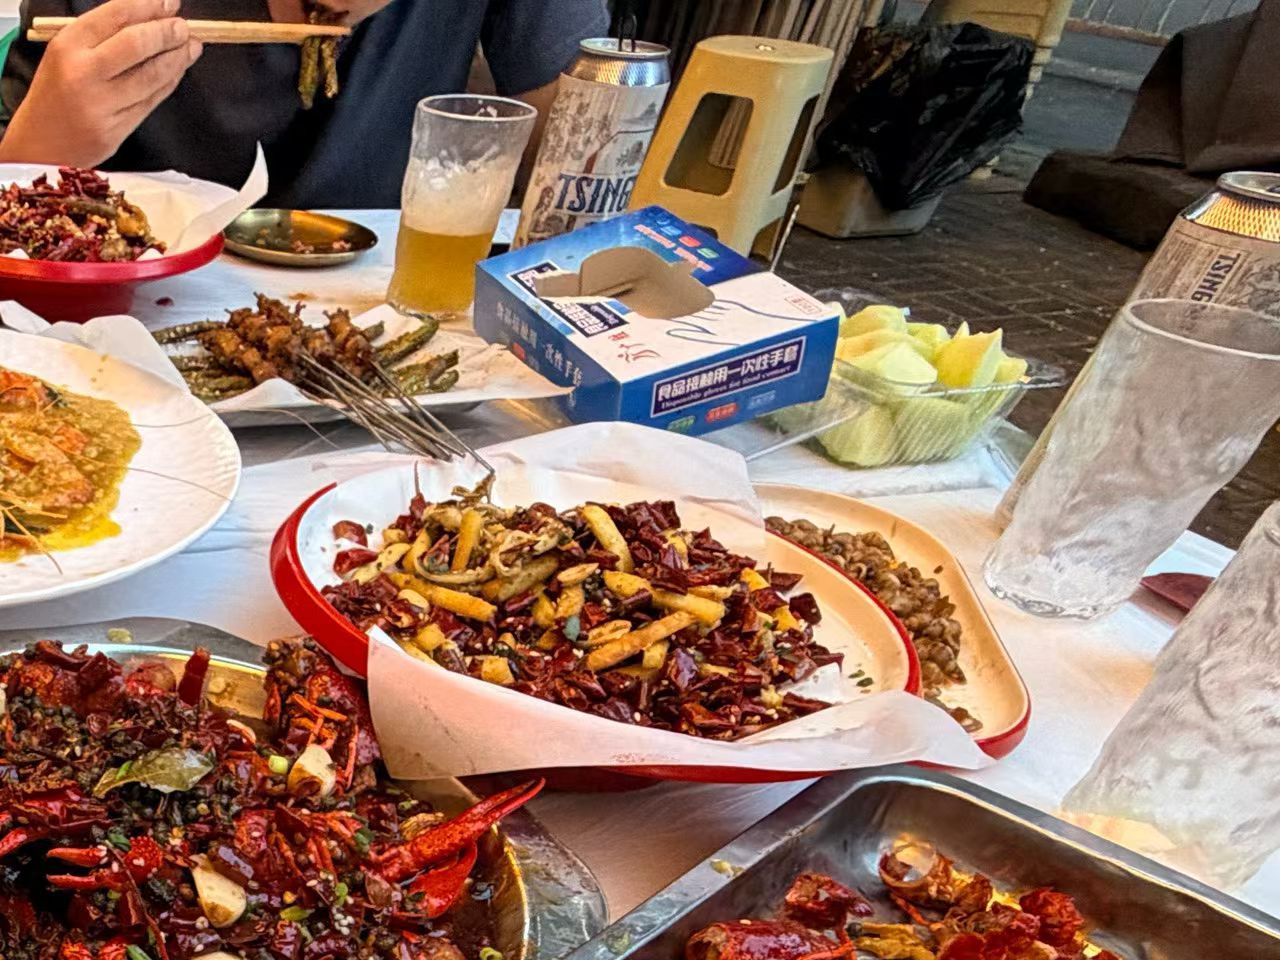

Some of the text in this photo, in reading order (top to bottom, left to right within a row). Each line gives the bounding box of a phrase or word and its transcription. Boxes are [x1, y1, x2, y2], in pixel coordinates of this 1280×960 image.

[657, 343, 800, 402] 食品接触用一次性手套
